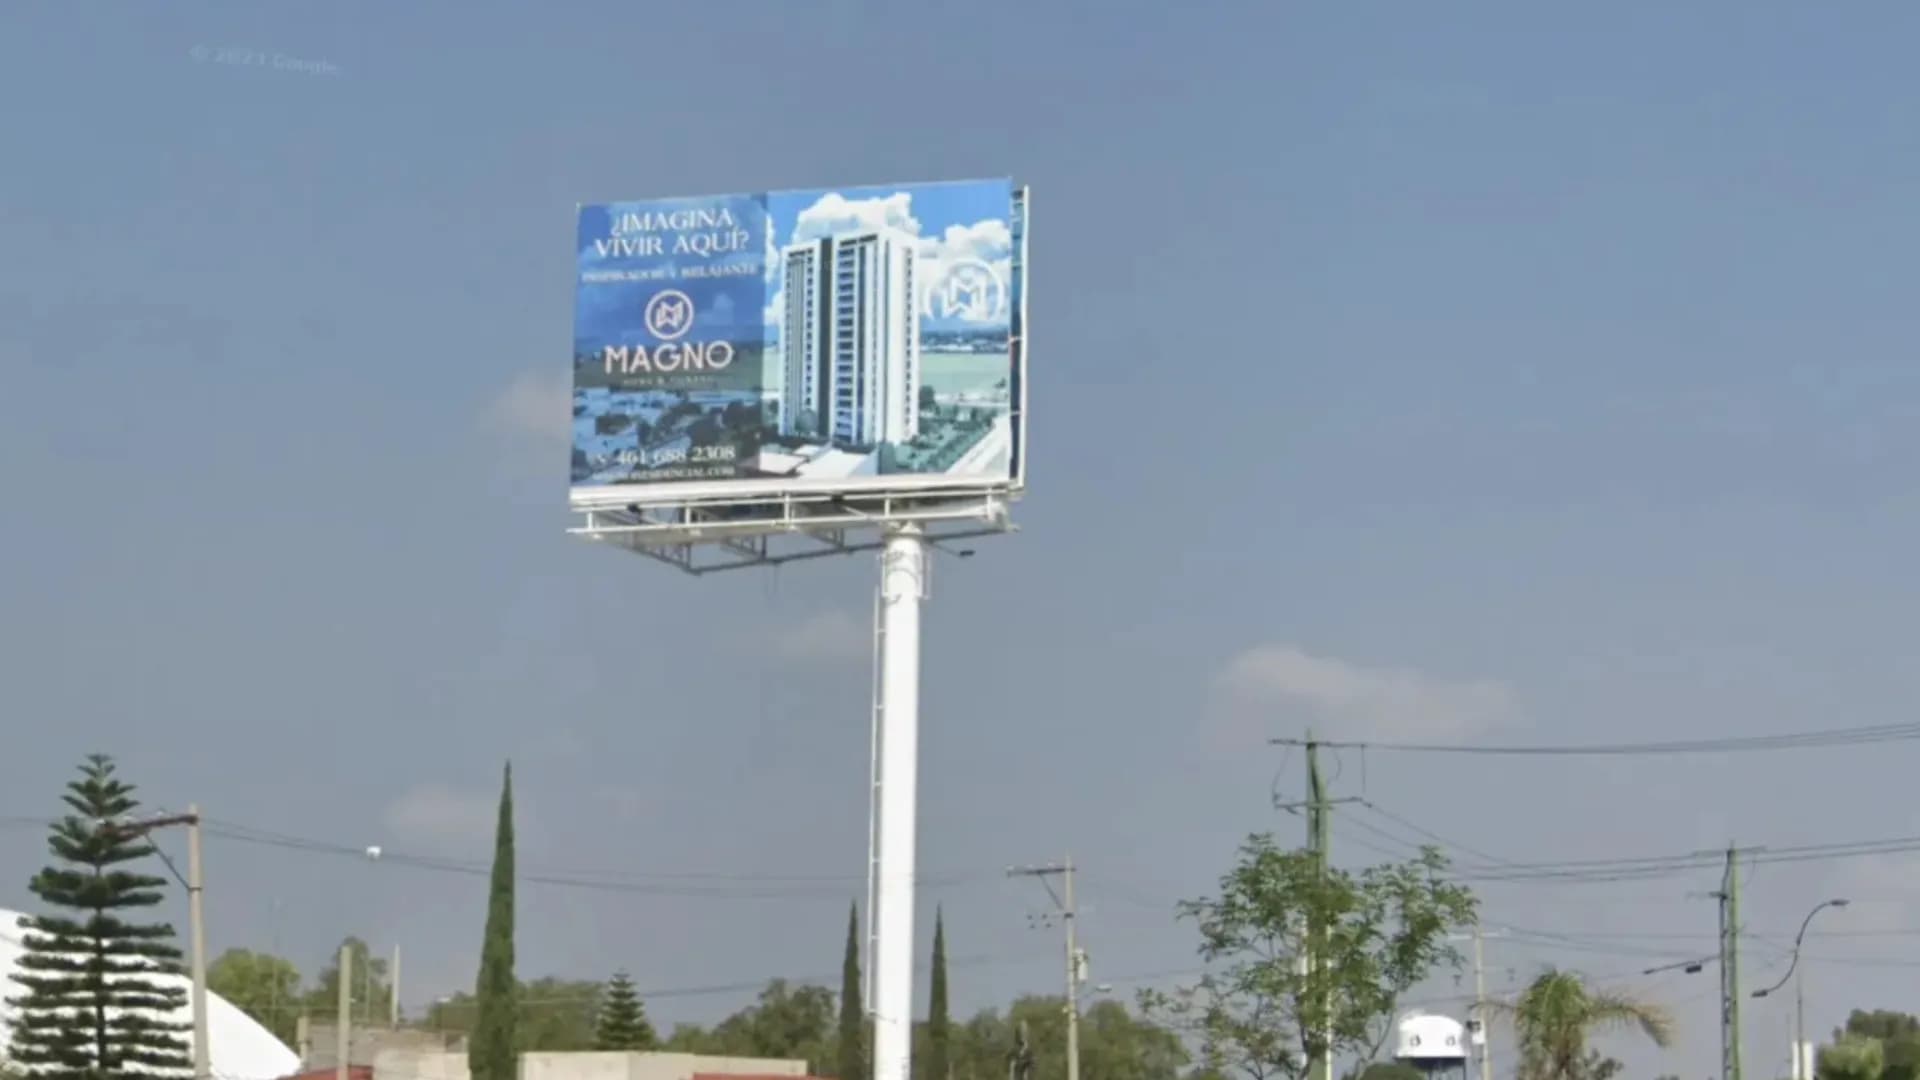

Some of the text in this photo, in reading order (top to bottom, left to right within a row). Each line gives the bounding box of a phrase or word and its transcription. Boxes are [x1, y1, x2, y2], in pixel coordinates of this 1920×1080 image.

[611, 207, 733, 236] ¿IMAGINA
[594, 228, 750, 258] VIVIR AQUÍ?
[604, 340, 734, 374] MAGNO
[616, 448, 647, 466] 461
[691, 445, 736, 463] 2308
